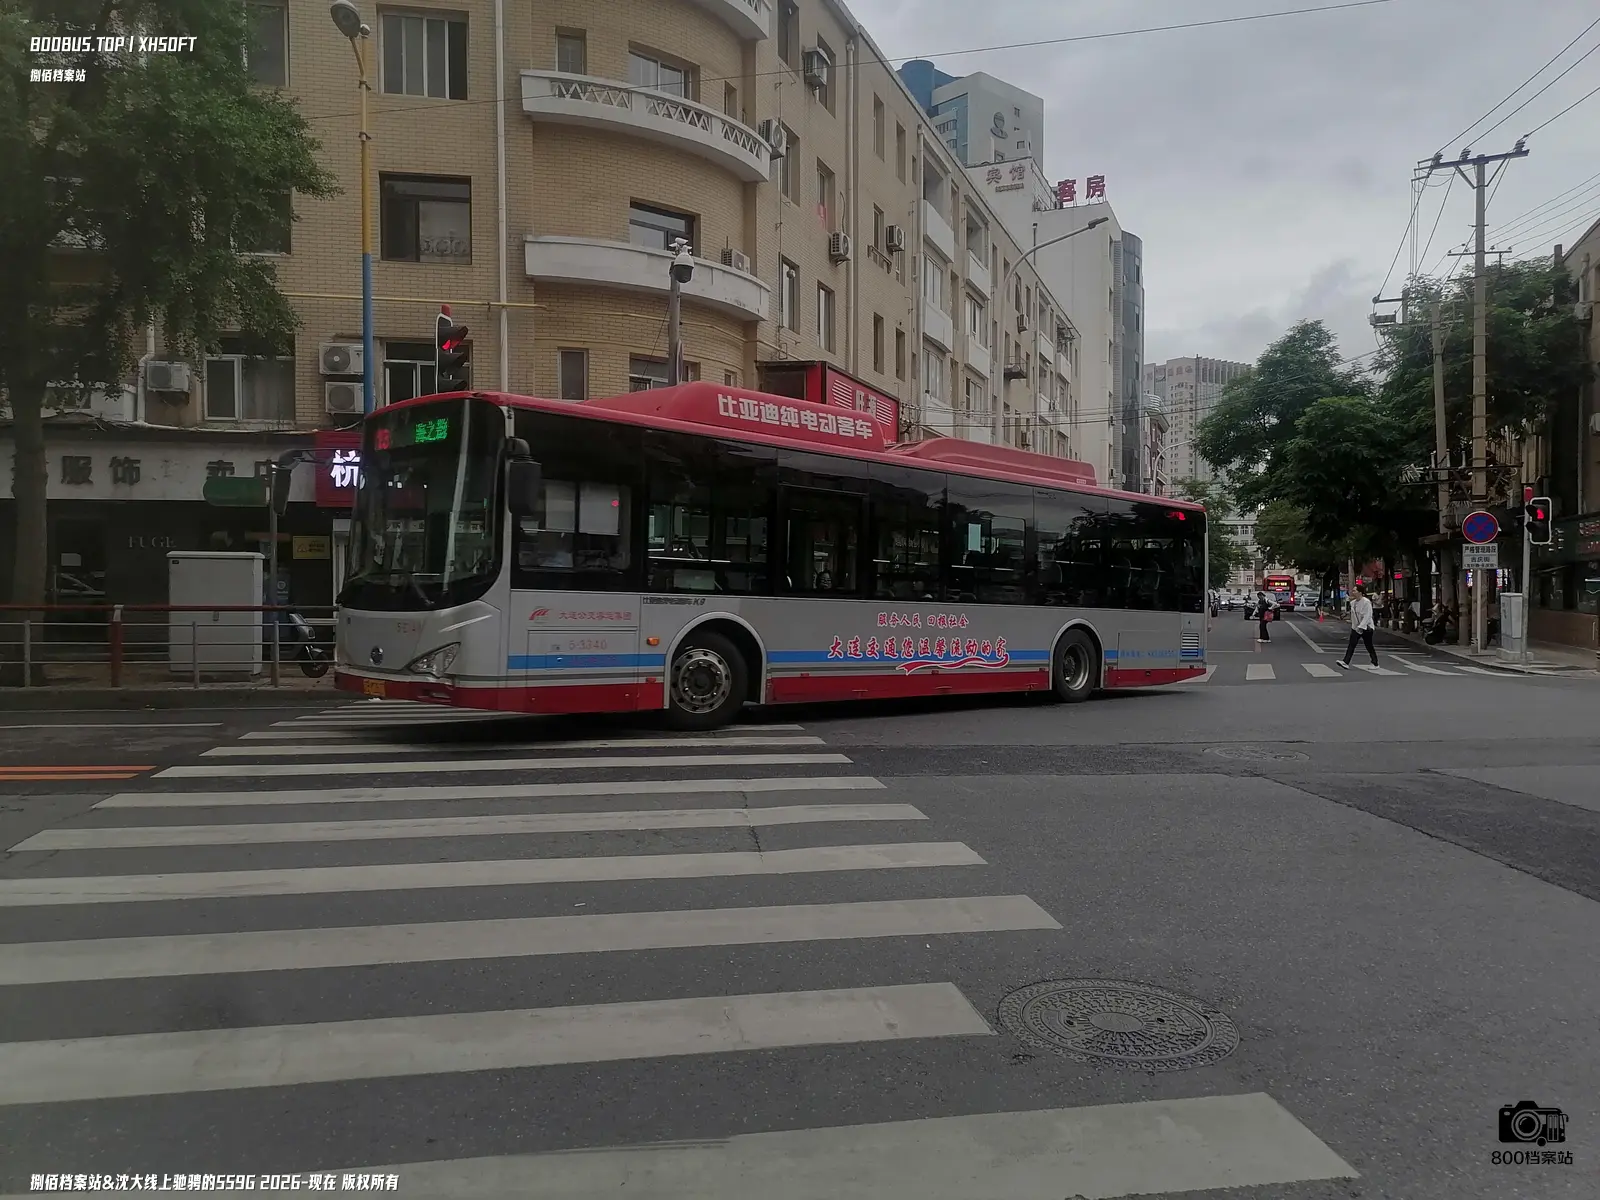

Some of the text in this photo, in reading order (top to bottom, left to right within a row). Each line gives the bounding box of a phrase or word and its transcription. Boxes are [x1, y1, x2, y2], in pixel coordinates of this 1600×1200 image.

[986, 164, 1026, 185] 宾馆
[1057, 175, 1106, 203] 客房
[717, 393, 873, 440] 比亚迪纯电动客车
[60, 455, 142, 486] 服饰
[330, 449, 366, 490] 杭
[877, 612, 970, 629] 服务人民 回报社会
[827, 635, 1010, 660] 大连交通您温馨流动的家
